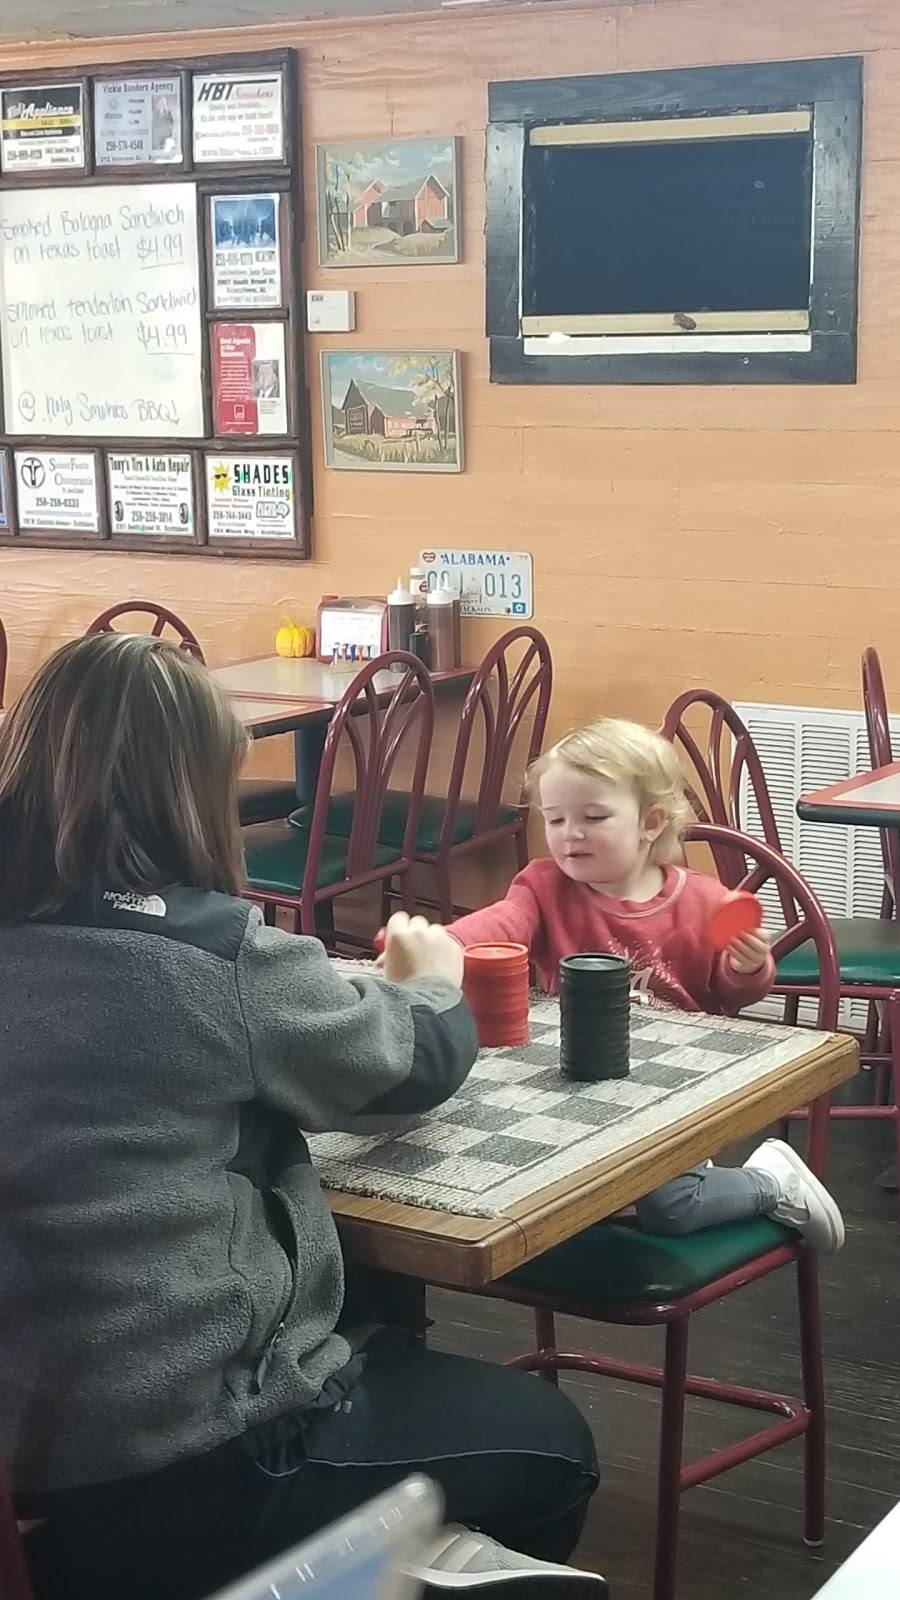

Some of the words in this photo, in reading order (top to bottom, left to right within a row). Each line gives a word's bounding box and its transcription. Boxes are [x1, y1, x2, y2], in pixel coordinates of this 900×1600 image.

[151, 81, 174, 92] Agency
[198, 82, 234, 101] HBT
[60, 210, 112, 242] Bologna
[119, 203, 184, 231] Sandwich
[13, 246, 30, 264] on
[87, 235, 121, 261] toast
[137, 233, 183, 263] $4.99
[12, 326, 30, 349] on
[82, 321, 113, 344] toast
[137, 321, 188, 349] $4.99
[18, 391, 36, 422] @
[77, 392, 128, 422] Smokes
[132, 398, 180, 426] BBQ!
[152, 458, 166, 472] Auto
[168, 458, 190, 476] Repair
[234, 464, 289, 484] SHADES
[232, 485, 256, 497] Glass
[258, 485, 290, 500] Tinting
[442, 552, 506, 566] ALABAMA
[484, 573, 522, 599] 013
